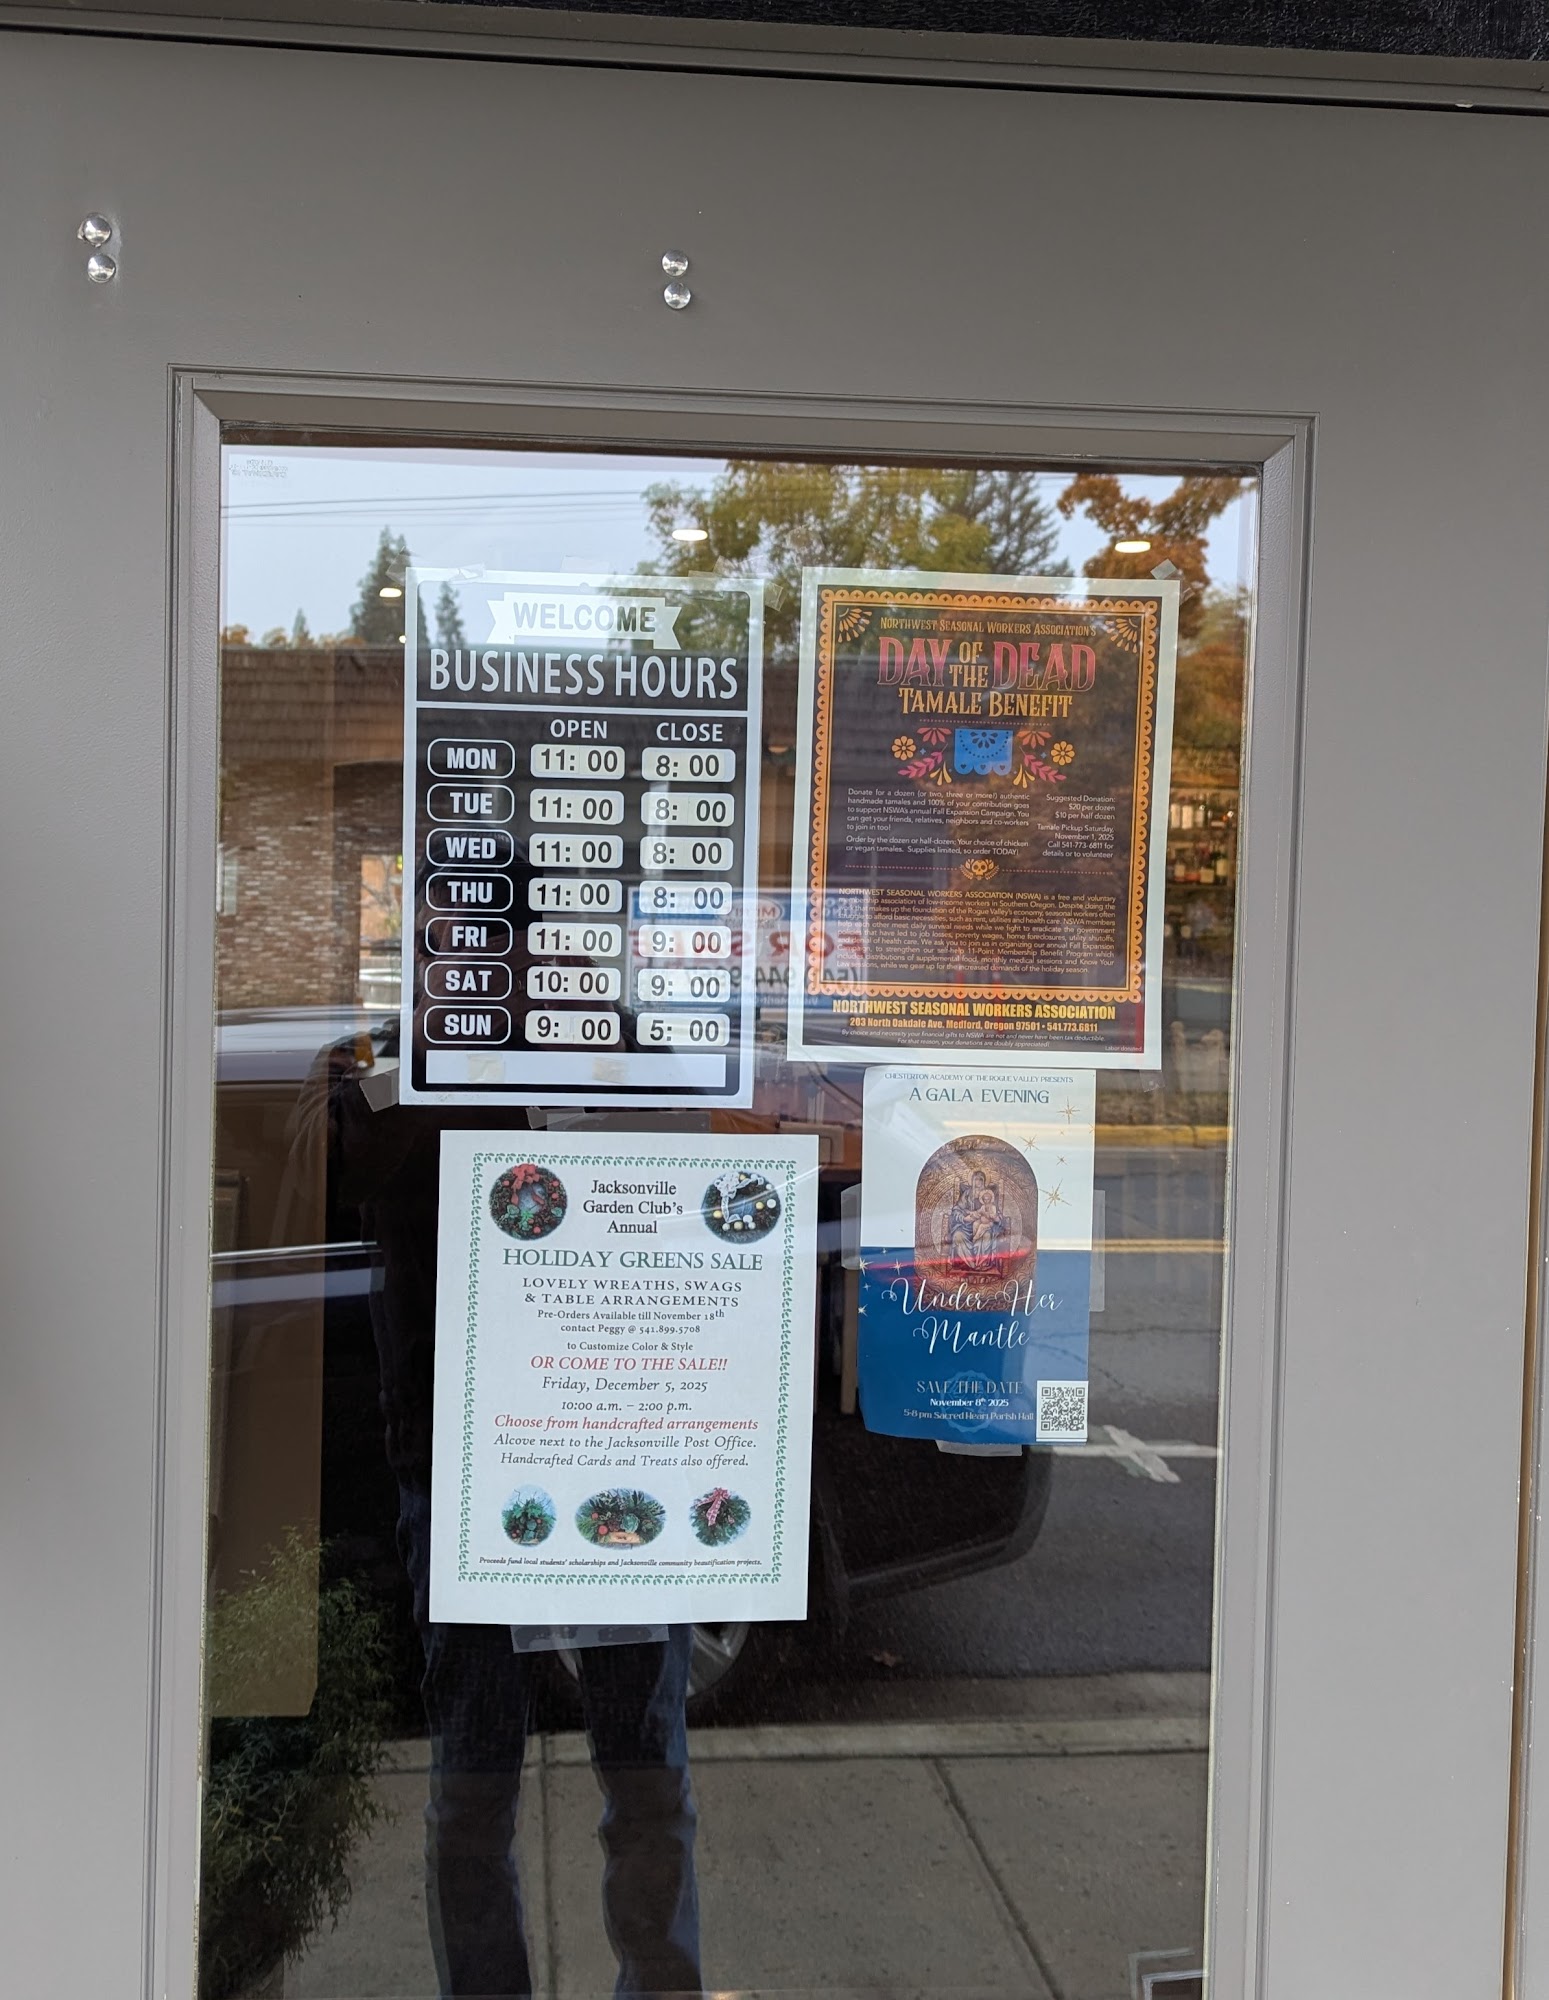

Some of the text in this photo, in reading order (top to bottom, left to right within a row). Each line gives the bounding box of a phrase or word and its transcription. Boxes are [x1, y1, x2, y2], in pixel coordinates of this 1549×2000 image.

[513, 601, 656, 634] WELCOME
[880, 616, 1097, 637] NORTHWEST SEASONAL WORKERS ASSOCIATION'S
[877, 636, 1096, 692] DAY OF THE DEAD
[429, 649, 739, 700] BUSINESS HOURS
[898, 687, 1072, 717] TAMALE BENEFIT
[550, 718, 722, 741] OPEN CLOSE
[446, 747, 496, 769] MON
[449, 792, 492, 814] TUE
[444, 836, 496, 858] WED
[447, 880, 492, 903] THU
[451, 925, 486, 947] FRI
[445, 969, 492, 991] SAT
[832, 999, 1115, 1019] NORTHWEST SEASONAL WORKERS ASSOCIATION
[444, 1013, 491, 1035] SUN
[849, 1017, 1097, 1032] 203 North Oakdale Ave. Medford, Oregon 97501 541.773.6811
[884, 1072, 928, 1080] CHESTERTON
[1040, 1075, 1073, 1083] PRESENTS
[908, 1086, 1049, 1103] A GALA EVENING
[590, 1179, 676, 1195] Jacksonville
[582, 1199, 633, 1213] Garden
[606, 1219, 657, 1233] Annual
[502, 1248, 762, 1270] HOLIDAY GREENS SALE
[522, 1277, 741, 1292] LOVELY WREATHS, SWAGS
[524, 1292, 738, 1307] & TABLE ARRANGEMENTS
[881, 1277, 1063, 1317] Under Her
[537, 1309, 590, 1319] Pre-Orders
[592, 1310, 636, 1319] Available
[637, 1311, 651, 1320] till
[653, 1311, 701, 1320] November
[560, 1323, 700, 1335] contact Peggy @ 541.899.5708
[912, 1315, 1031, 1354] Mantle
[567, 1341, 693, 1353] to Customize Color & Style
[530, 1355, 727, 1370] OR COME TO THE SALE!!
[541, 1375, 708, 1393] Friday, December 5, 2025
[954, 1381, 982, 1394] THE
[987, 1381, 1023, 1395] DATE
[561, 1401, 592, 1410] 10:00
[596, 1402, 621, 1410] a.m.
[638, 1402, 663, 1411] 2:00
[666, 1401, 691, 1414] p.m.
[929, 1398, 974, 1406] November
[987, 1398, 1009, 1406] 2025
[918, 1411, 932, 1419] pm
[933, 1408, 964, 1421] Sacred
[989, 1411, 1016, 1420] Parish
[1017, 1412, 1033, 1420] Hall
[494, 1414, 759, 1434] Choose from handcrafted arrangements
[493, 1432, 756, 1450] Alcove next to the Jacksonville Post Office.
[500, 1452, 748, 1469] Handcrafted Cards and Treats also offered.
[478, 1556, 506, 1564] Proceeds
[506, 1556, 522, 1566] fund
[523, 1556, 538, 1564] local
[568, 1558, 606, 1567] scholarships
[607, 1559, 619, 1567] and
[618, 1558, 657, 1568] Jacksonville
[658, 1559, 692, 1568] community
[693, 1558, 735, 1567] beautification
[736, 1558, 762, 1566] projects.
